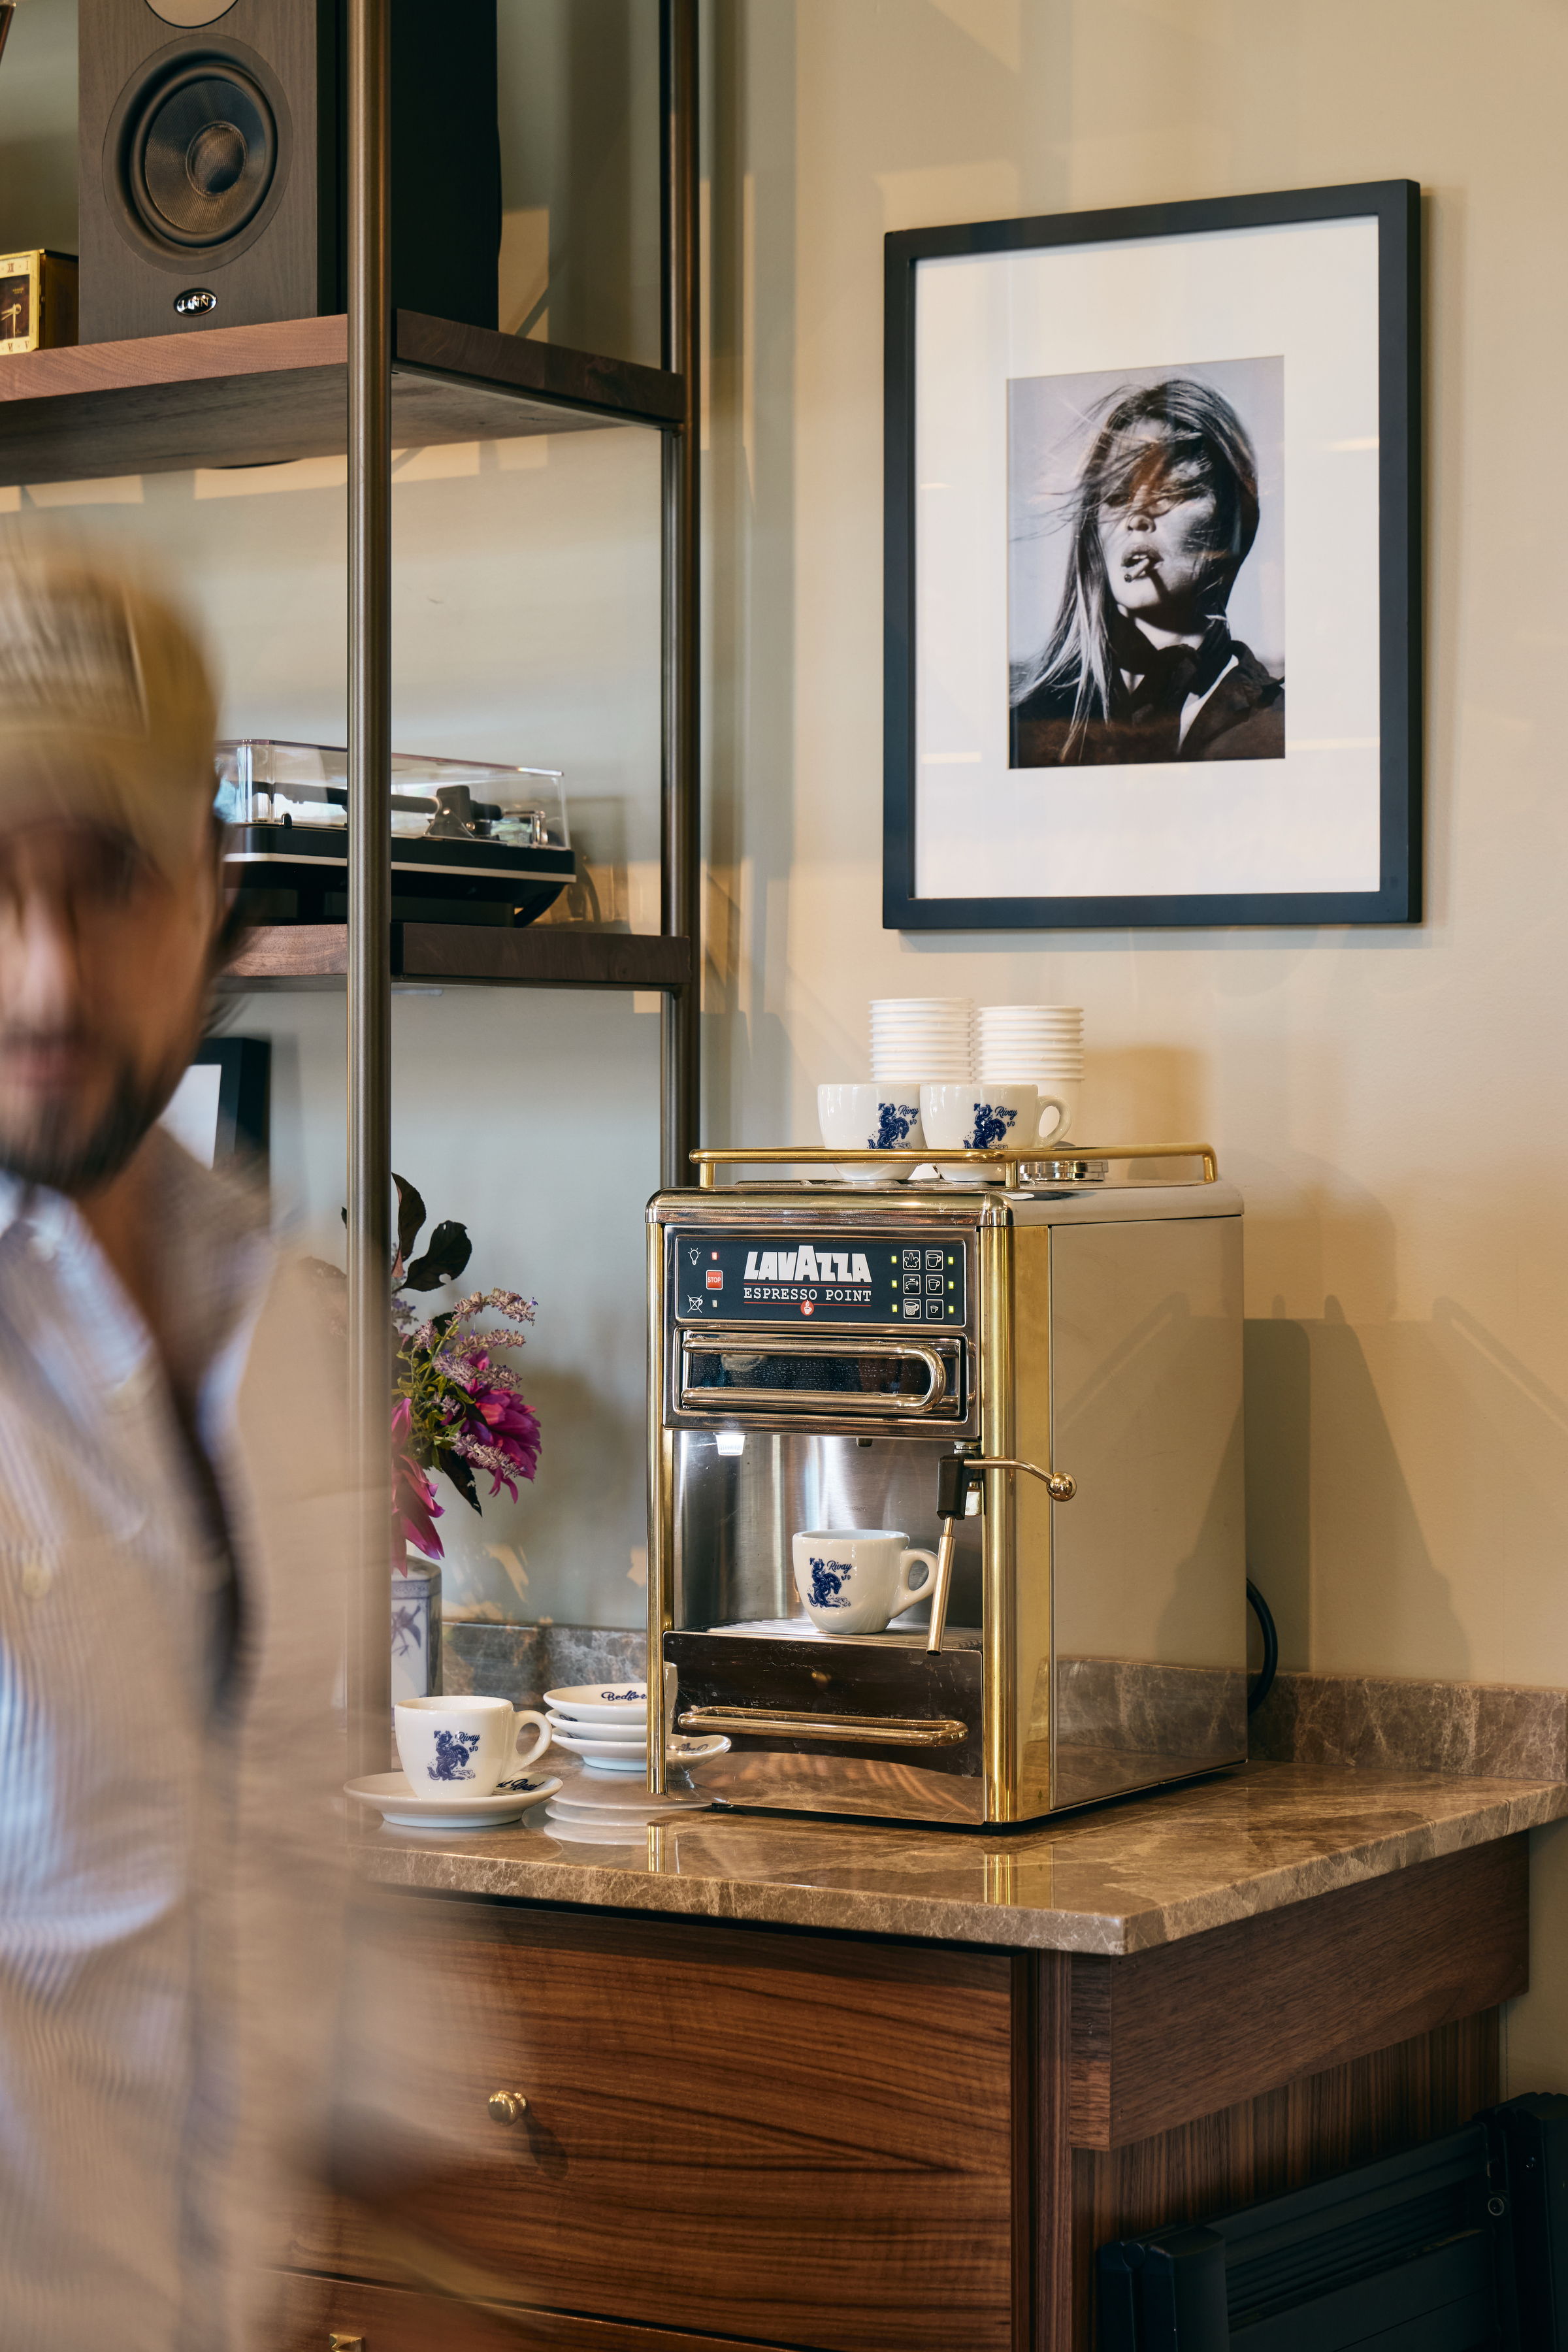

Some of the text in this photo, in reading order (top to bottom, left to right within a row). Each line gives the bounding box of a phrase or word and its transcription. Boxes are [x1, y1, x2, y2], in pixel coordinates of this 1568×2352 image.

[181, 295, 209, 310] LINN
[898, 1105, 919, 1118] Rivay
[995, 1106, 1018, 1120] Rivay
[743, 1245, 872, 1282] LAVAZZA
[743, 1288, 872, 1301] ESPRESSO POINT
[826, 1560, 852, 1574] Rivay
[601, 1690, 647, 1701] Bedfor
[455, 1731, 480, 1745] Rivay
